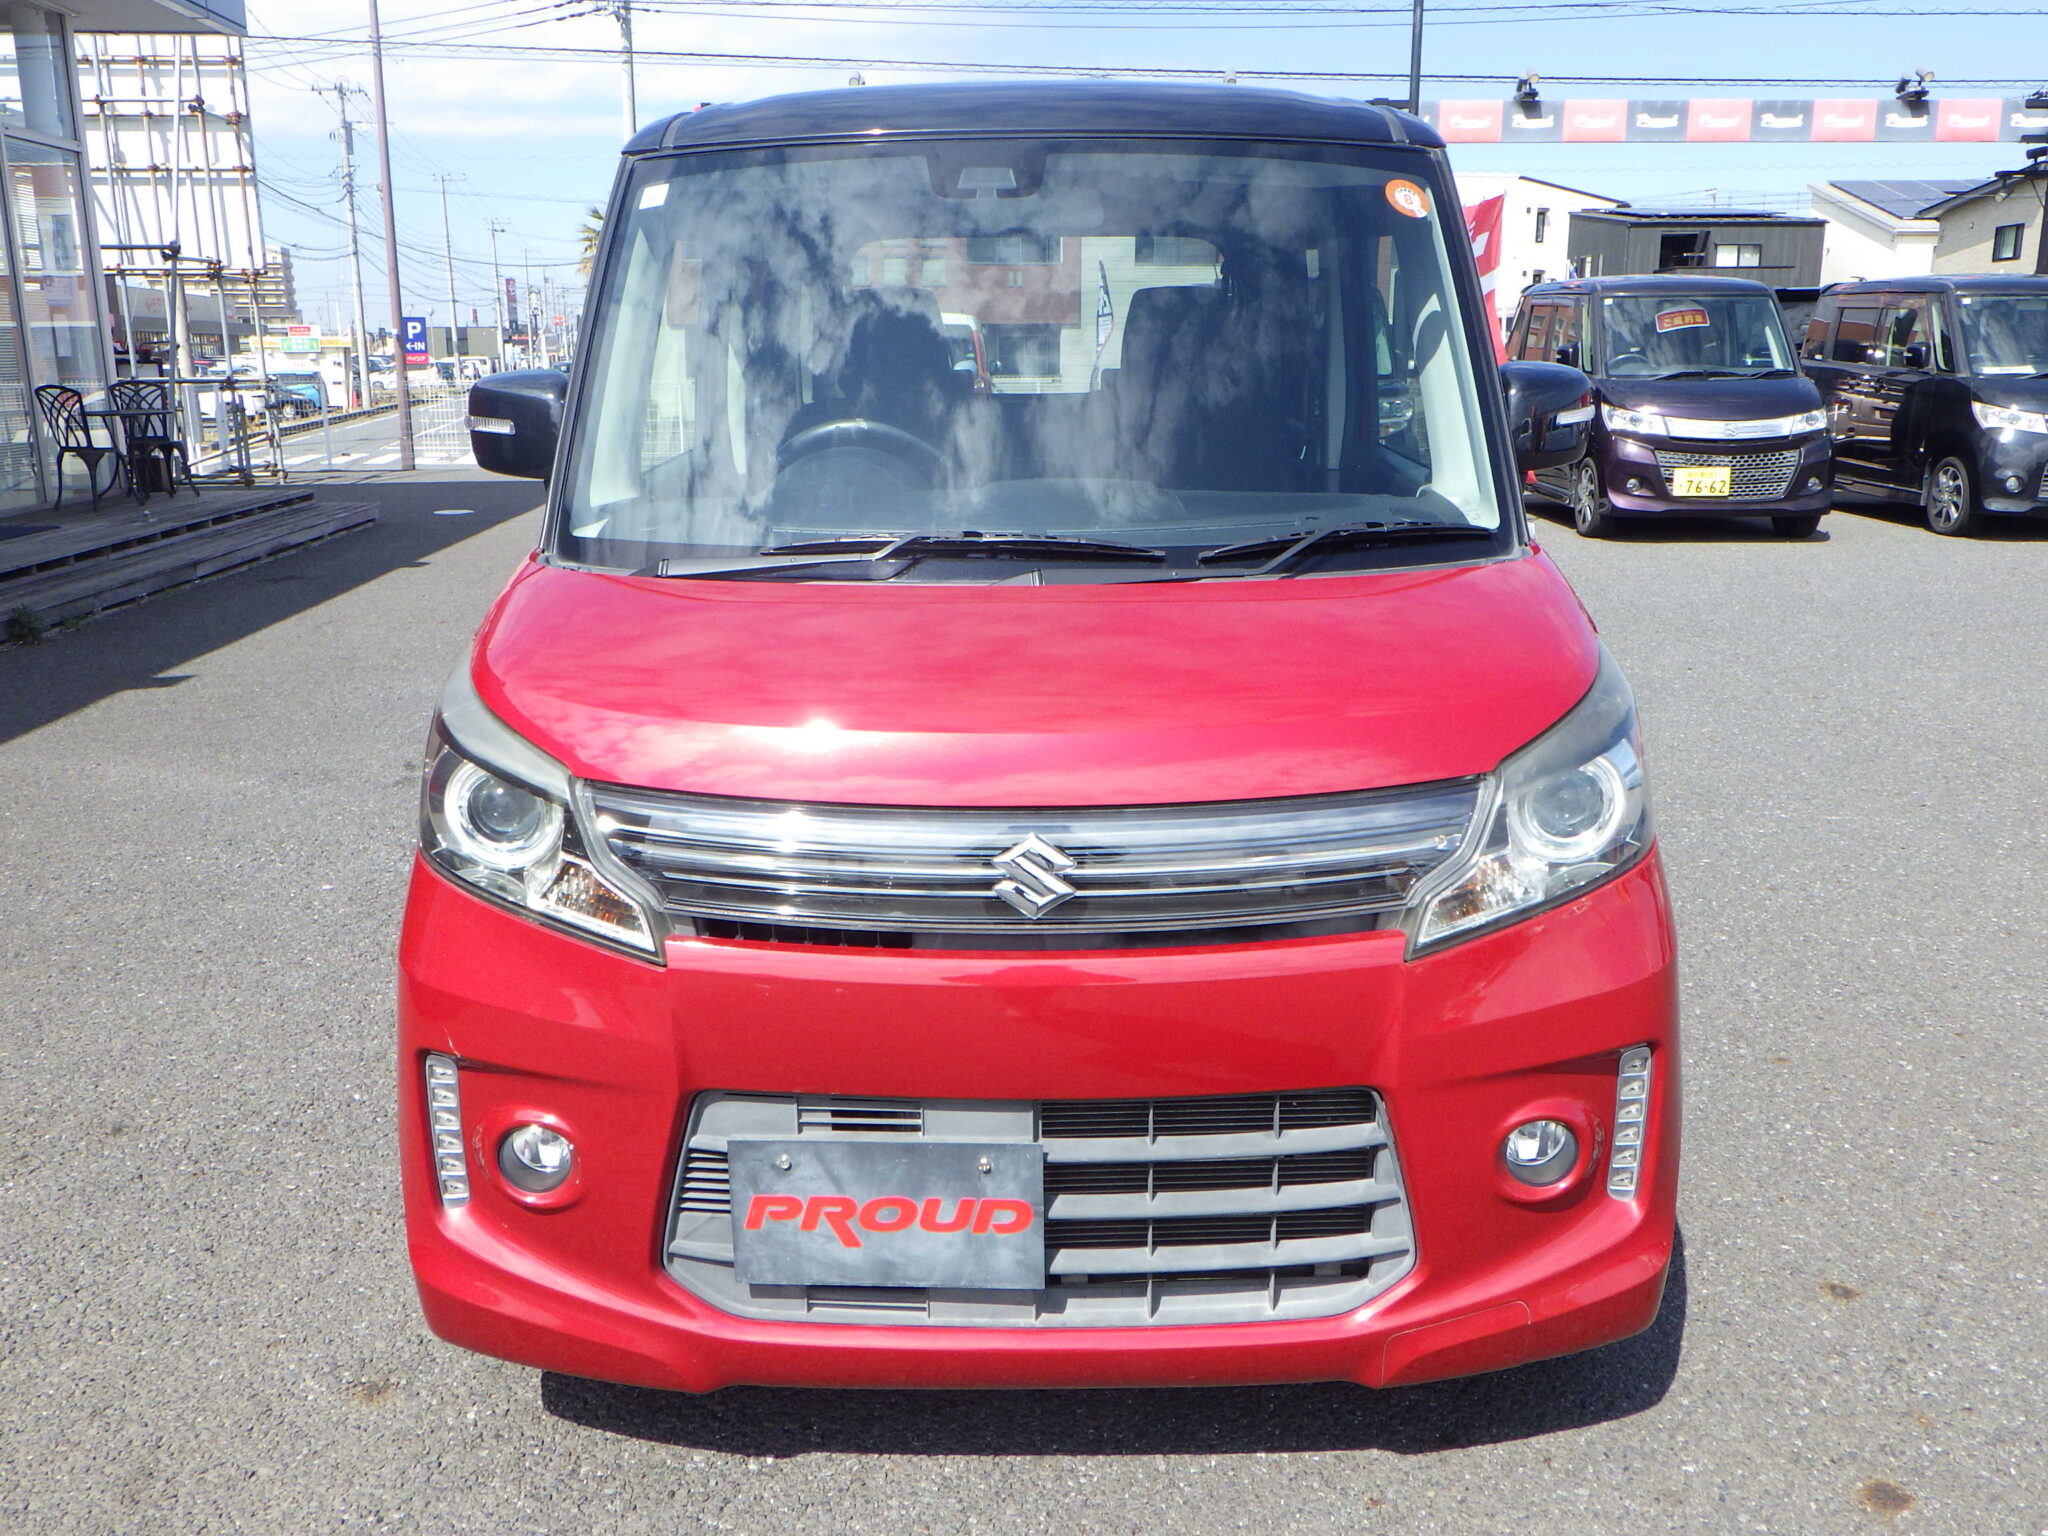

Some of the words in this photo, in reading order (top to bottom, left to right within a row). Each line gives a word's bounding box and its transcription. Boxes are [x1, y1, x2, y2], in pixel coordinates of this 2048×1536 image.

[407, 322, 421, 339] P
[414, 342, 425, 350] IN
[744, 1194, 1035, 1248] PROUD
